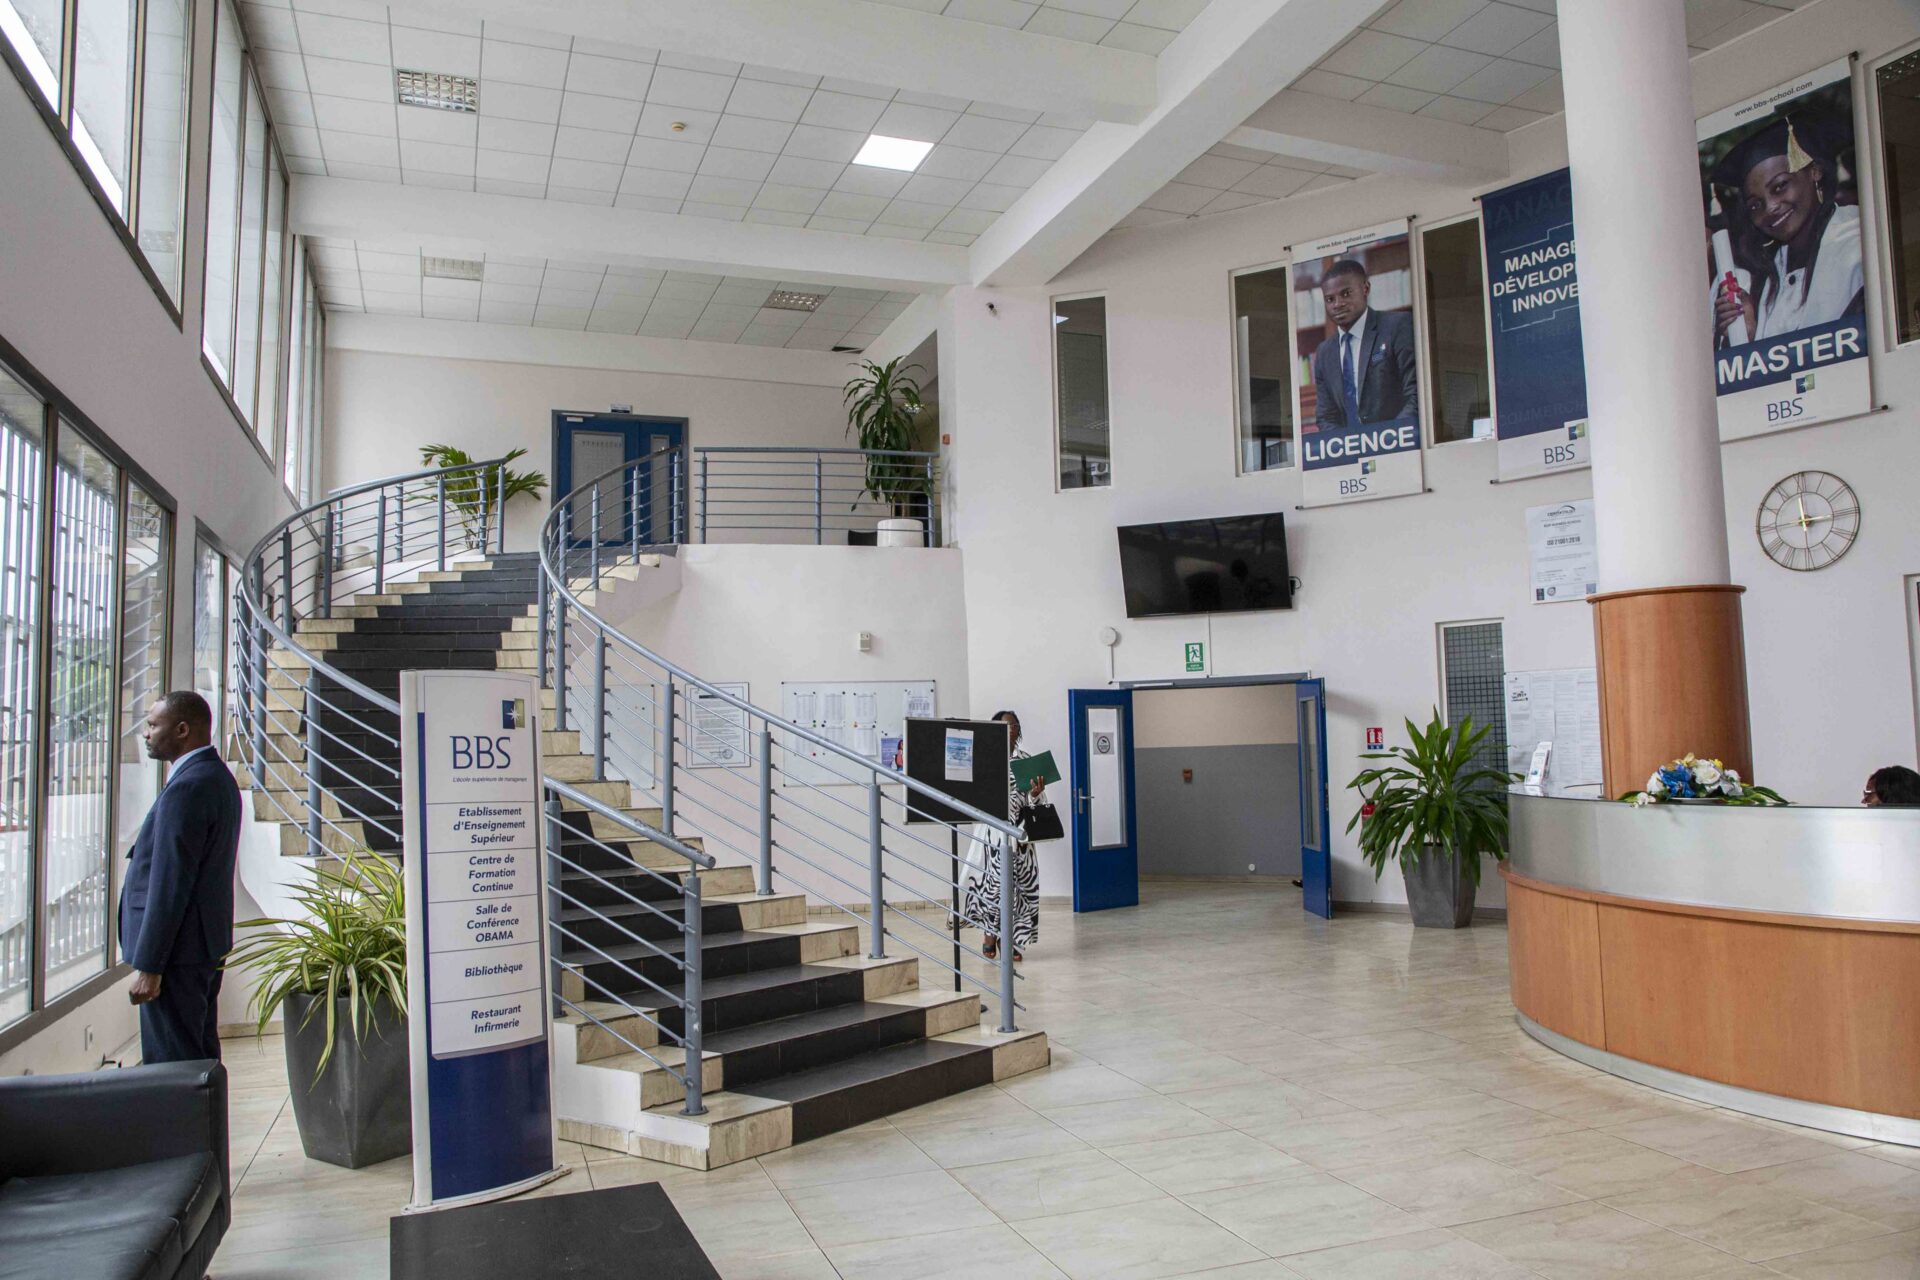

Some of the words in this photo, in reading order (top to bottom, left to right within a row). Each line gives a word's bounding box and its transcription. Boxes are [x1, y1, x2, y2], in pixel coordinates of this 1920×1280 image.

[1734, 80, 1813, 117] www.bbs-school.com
[1493, 262, 1577, 297] DÉVELOP
[1718, 327, 1861, 385] MASTER
[1767, 397, 1803, 421] BBS
[1305, 425, 1416, 462] LICENCE
[1543, 443, 1575, 464] BBS
[1340, 477, 1368, 495] BBS
[449, 735, 511, 769] BBS
[459, 807, 522, 817] Etablissement
[453, 820, 526, 831] d'Enseignement
[471, 833, 515, 845] Supérieur
[469, 855, 502, 865] Centre
[504, 854, 515, 863] de
[468, 868, 516, 879] Formation
[472, 882, 514, 893] Continue
[475, 904, 499, 915] Salle
[501, 903, 512, 913] de
[467, 917, 519, 929] Conférence
[475, 930, 514, 943] OBAMA
[464, 963, 523, 977] Bibliothèque
[471, 1004, 521, 1020] Restaurant
[474, 1018, 520, 1034] Infirmerie
